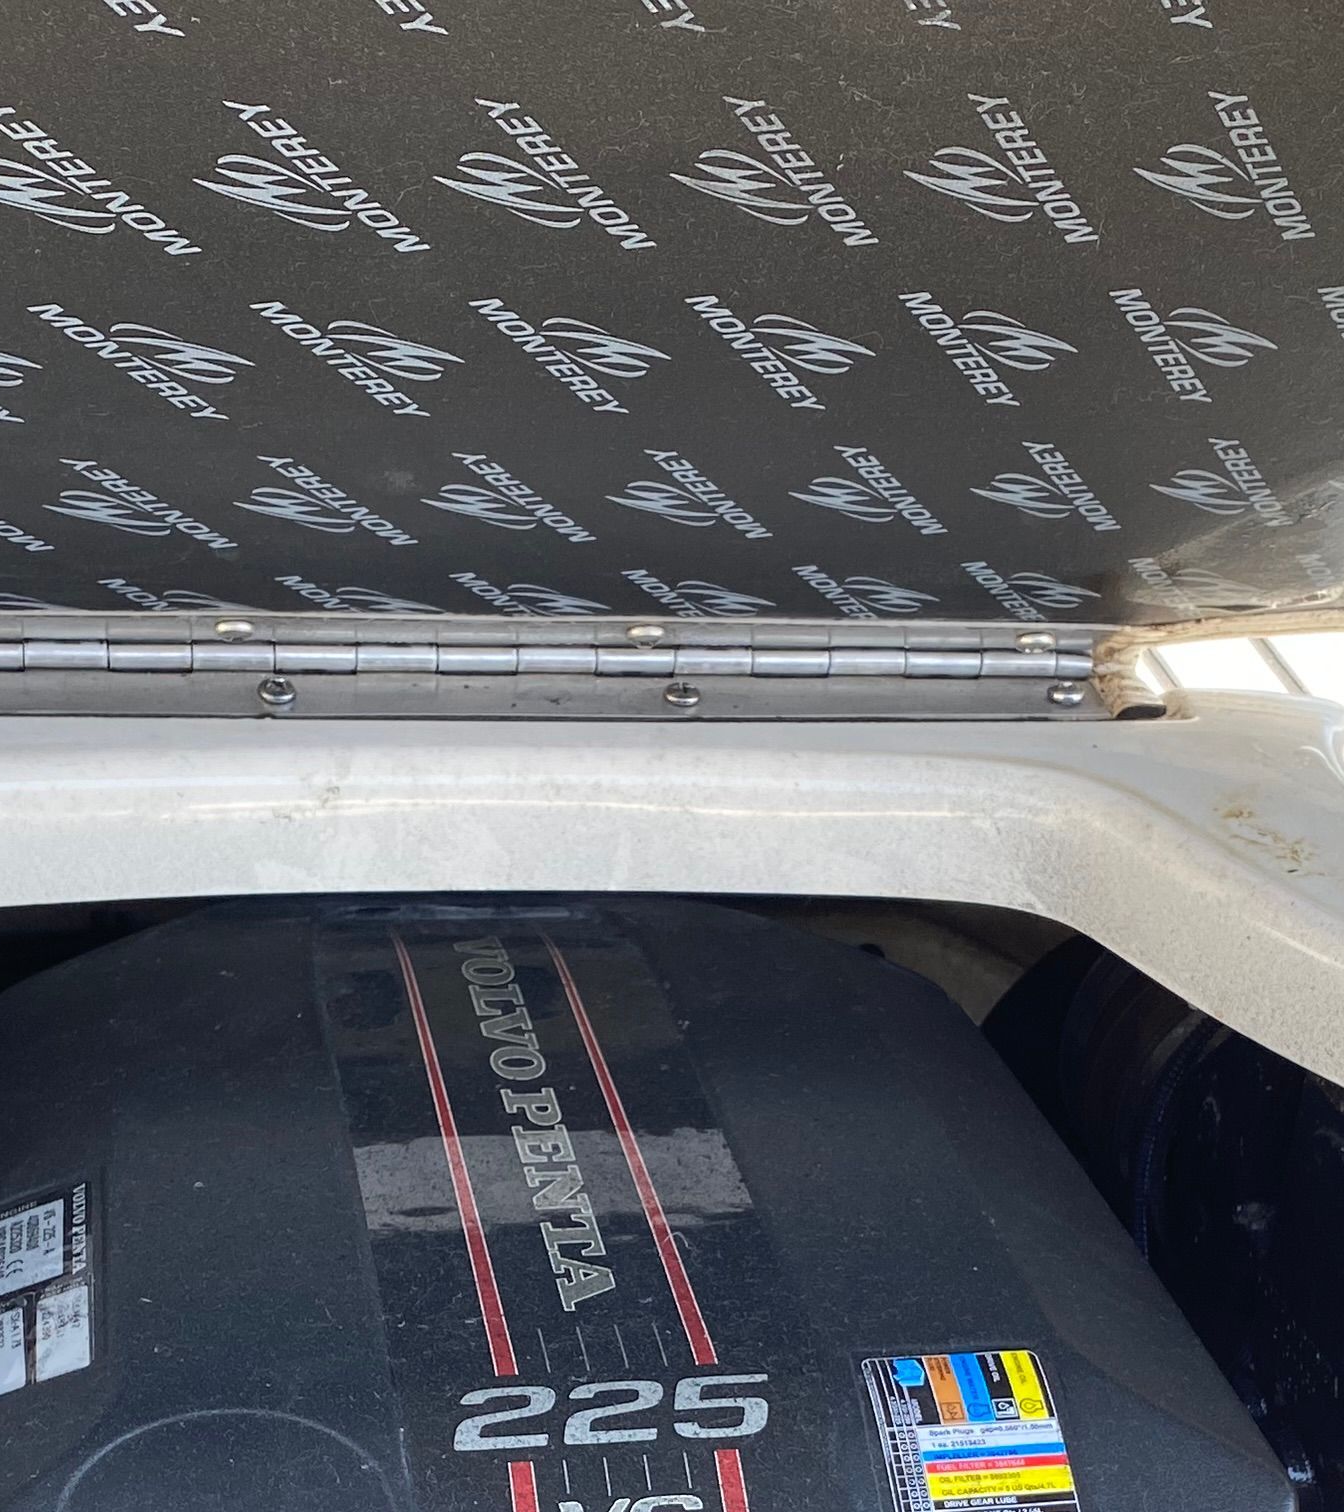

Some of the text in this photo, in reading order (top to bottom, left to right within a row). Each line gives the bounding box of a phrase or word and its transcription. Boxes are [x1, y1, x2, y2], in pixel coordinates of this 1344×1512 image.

[222, 100, 430, 252] MONTEREY
[474, 97, 657, 251] MONTEREY
[723, 95, 879, 247] MONTEREY
[967, 93, 1099, 245] MONTEREY
[1208, 90, 1316, 241] MONTEREY
[27, 303, 229, 421] MONTEREY
[250, 301, 430, 417] MONTEREY
[468, 297, 629, 414] MONTEREY
[685, 294, 825, 411] MONTEREY
[898, 291, 1020, 408] MONTEREY
[1108, 287, 1212, 403] MONTEREY
[59, 458, 238, 550] MONTEREY
[257, 455, 418, 546] MONTEREY
[451, 452, 597, 543] MONTEREY
[643, 449, 773, 540] MONTEREY
[834, 445, 949, 536] MONTEREY
[1021, 440, 1121, 532] MONTEREY
[1208, 436, 1291, 528] MONTEREY
[621, 569, 706, 617] MONTE
[792, 565, 878, 619] MONTER
[961, 561, 1049, 622] MONTERE
[453, 936, 617, 1312] VOLVO PENTA
[72, 1183, 87, 1275] VOLVO PENTA
[453, 1373, 769, 1452] 225
[936, 1463, 954, 1471] FUEL
[957, 1461, 985, 1470] FILTER
[939, 1474, 982, 1484] OIL FILTER
[942, 1488, 955, 1496] OIL
[957, 1485, 996, 1496] CAPACITY
[1012, 1483, 1023, 1491] US
[944, 1496, 1017, 1508] DRIVE GEAR LUBE
